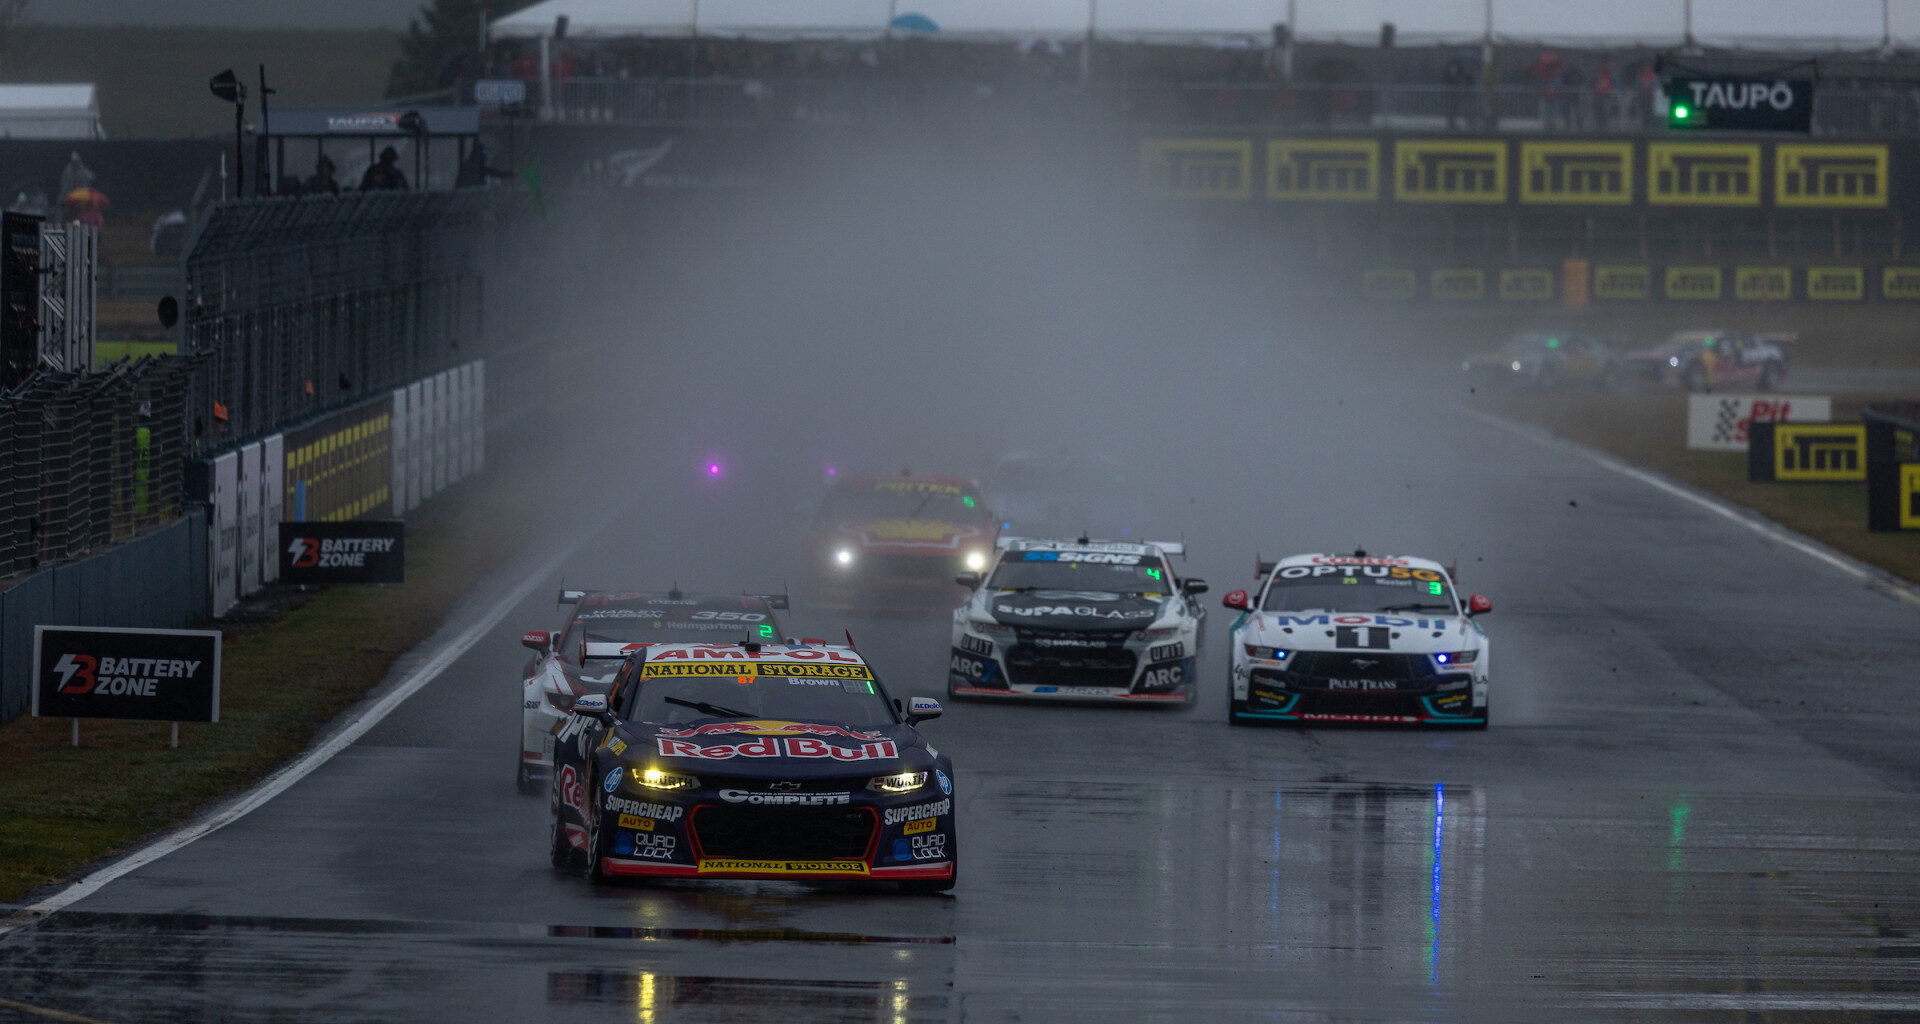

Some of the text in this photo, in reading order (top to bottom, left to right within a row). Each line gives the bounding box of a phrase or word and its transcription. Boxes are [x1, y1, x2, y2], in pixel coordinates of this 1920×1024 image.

[1781, 434, 1858, 471] itm
[321, 538, 396, 554] BATTERY
[319, 552, 366, 567] ZONE
[1146, 568, 1160, 580] 4
[1429, 581, 1442, 595] 3
[691, 611, 767, 622] 350
[1278, 615, 1446, 630] Mobil
[667, 621, 744, 631] Heimgartner
[759, 625, 773, 638] 2
[1351, 627, 1370, 647] 1
[651, 649, 858, 664] AMPOL
[100, 658, 201, 679] BATTERY
[645, 664, 864, 678] NATIONAL STORAGE
[95, 677, 157, 696] ZONE
[738, 676, 840, 687] 87 Brown
[865, 681, 875, 694] 1
[1328, 678, 1360, 690] PALM
[657, 736, 899, 761] Red Bull
[718, 789, 851, 805] COMPLETE
[606, 795, 683, 822] SUPERCHEAP
[885, 798, 950, 825] SUPERCHEAP
[621, 815, 651, 828] AUTO
[906, 820, 933, 832] AUTO
[635, 832, 675, 848] QUAD
[912, 833, 945, 849] QUAD
[633, 846, 675, 859] LOCK
[912, 847, 946, 859] LOCK
[703, 860, 862, 872] NATIONAL STORAGE
